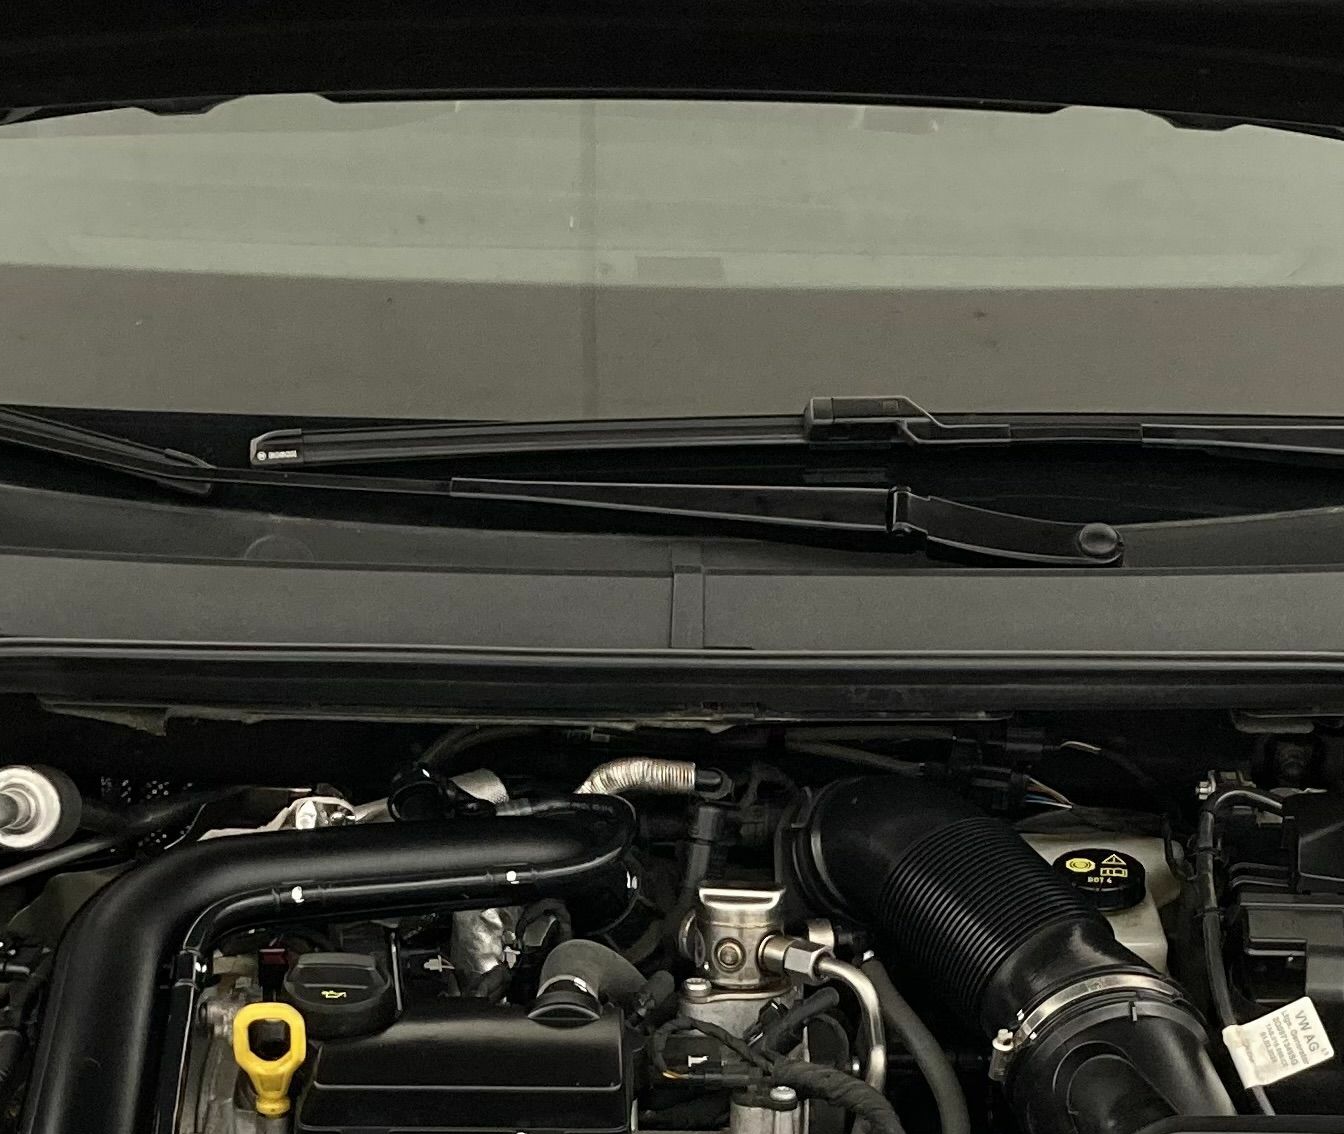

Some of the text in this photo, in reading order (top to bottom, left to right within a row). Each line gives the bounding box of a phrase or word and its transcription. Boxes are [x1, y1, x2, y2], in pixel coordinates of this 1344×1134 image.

[1087, 876, 1113, 884] DOT 4
[1294, 1009, 1320, 1053] VW AG
